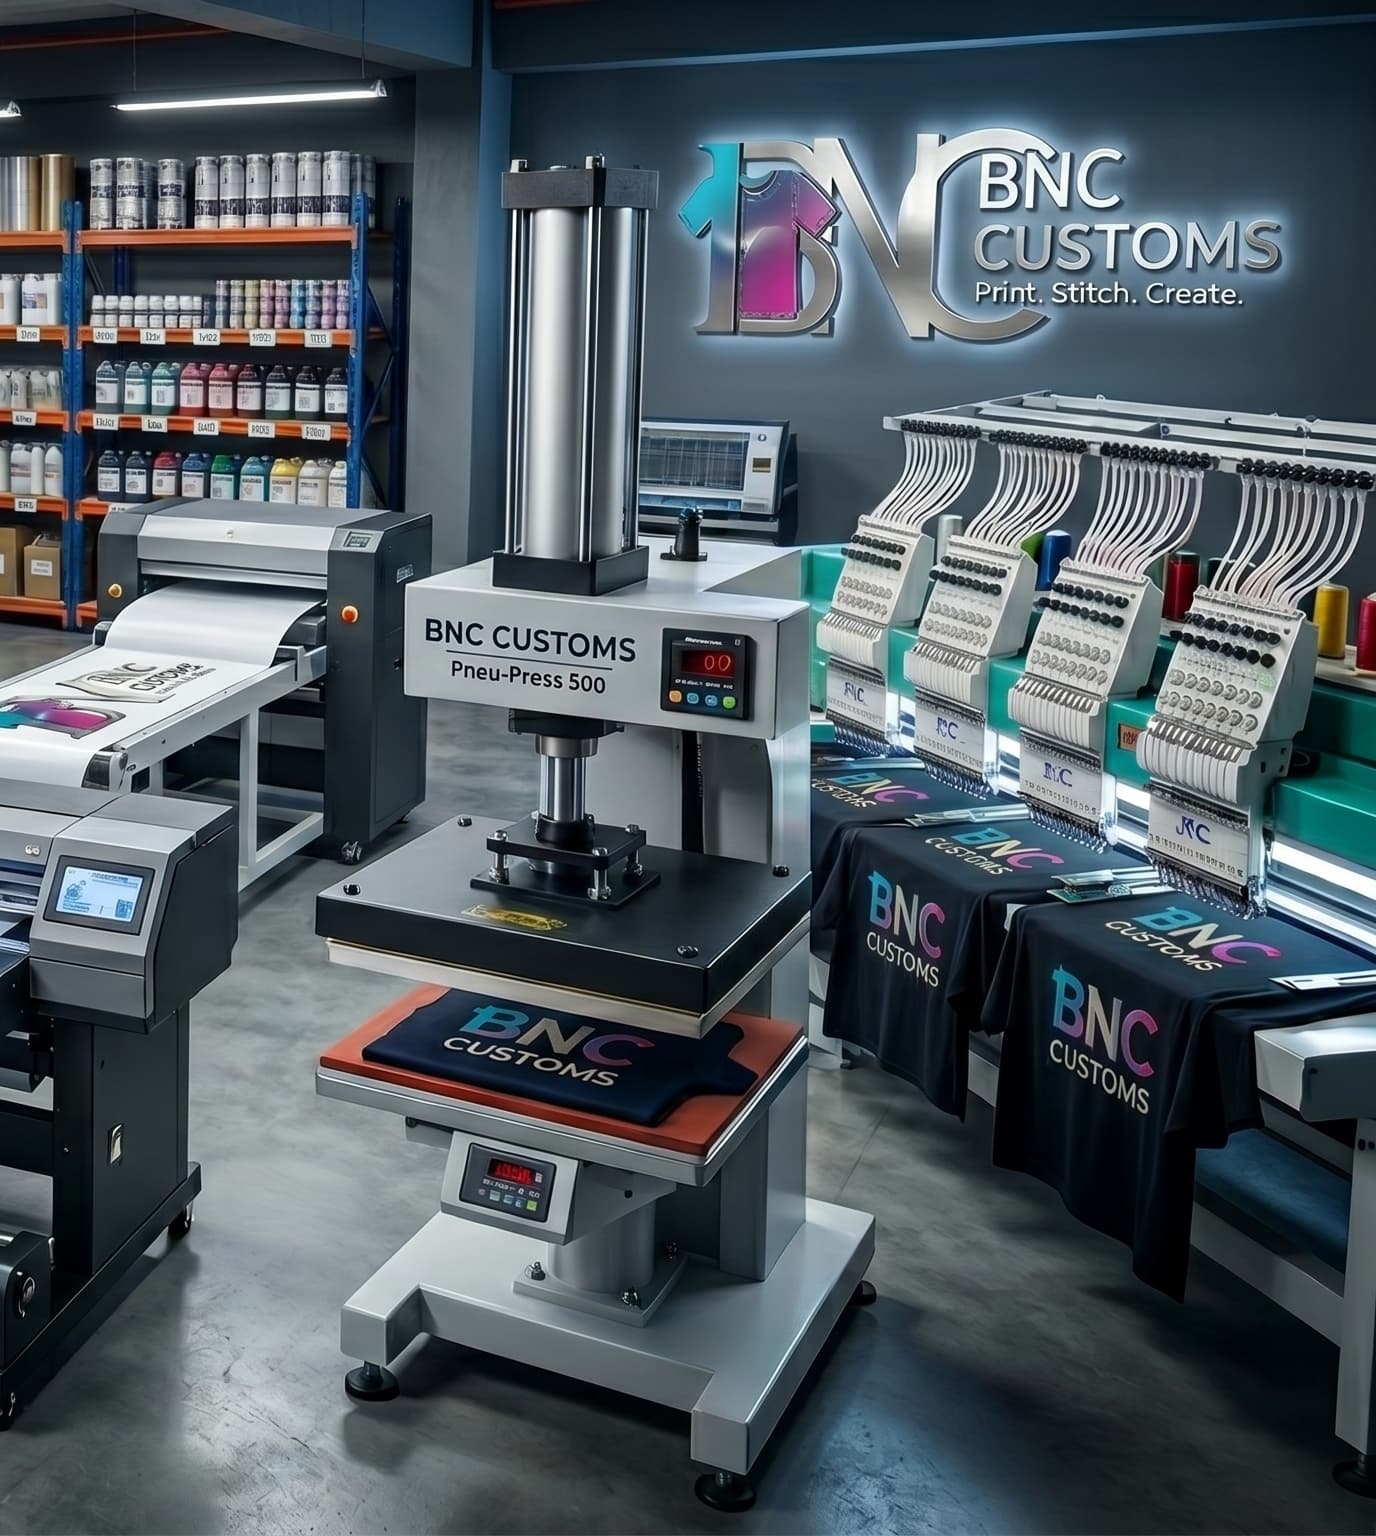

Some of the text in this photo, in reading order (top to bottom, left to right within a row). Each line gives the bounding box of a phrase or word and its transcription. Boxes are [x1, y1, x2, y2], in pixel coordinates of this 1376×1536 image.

[978, 147, 1126, 211] BNC
[973, 218, 1282, 272] CUSTOMS
[974, 281, 1244, 306] Print. Stitch. Create.
[425, 618, 637, 663] BNC CUSTOMS
[451, 660, 606, 694] Pneu-Press 500
[956, 827, 1065, 869] BNC
[867, 870, 946, 959] BNC
[1132, 906, 1282, 966] BNC
[867, 931, 940, 988] CUSTOMS
[1105, 918, 1222, 972] CUSTOMS
[460, 1004, 656, 1068] BNC
[1051, 964, 1159, 1078] BNC
[443, 1037, 620, 1087] CUSTOMS
[1049, 1040, 1150, 1115] CUSTOMS
